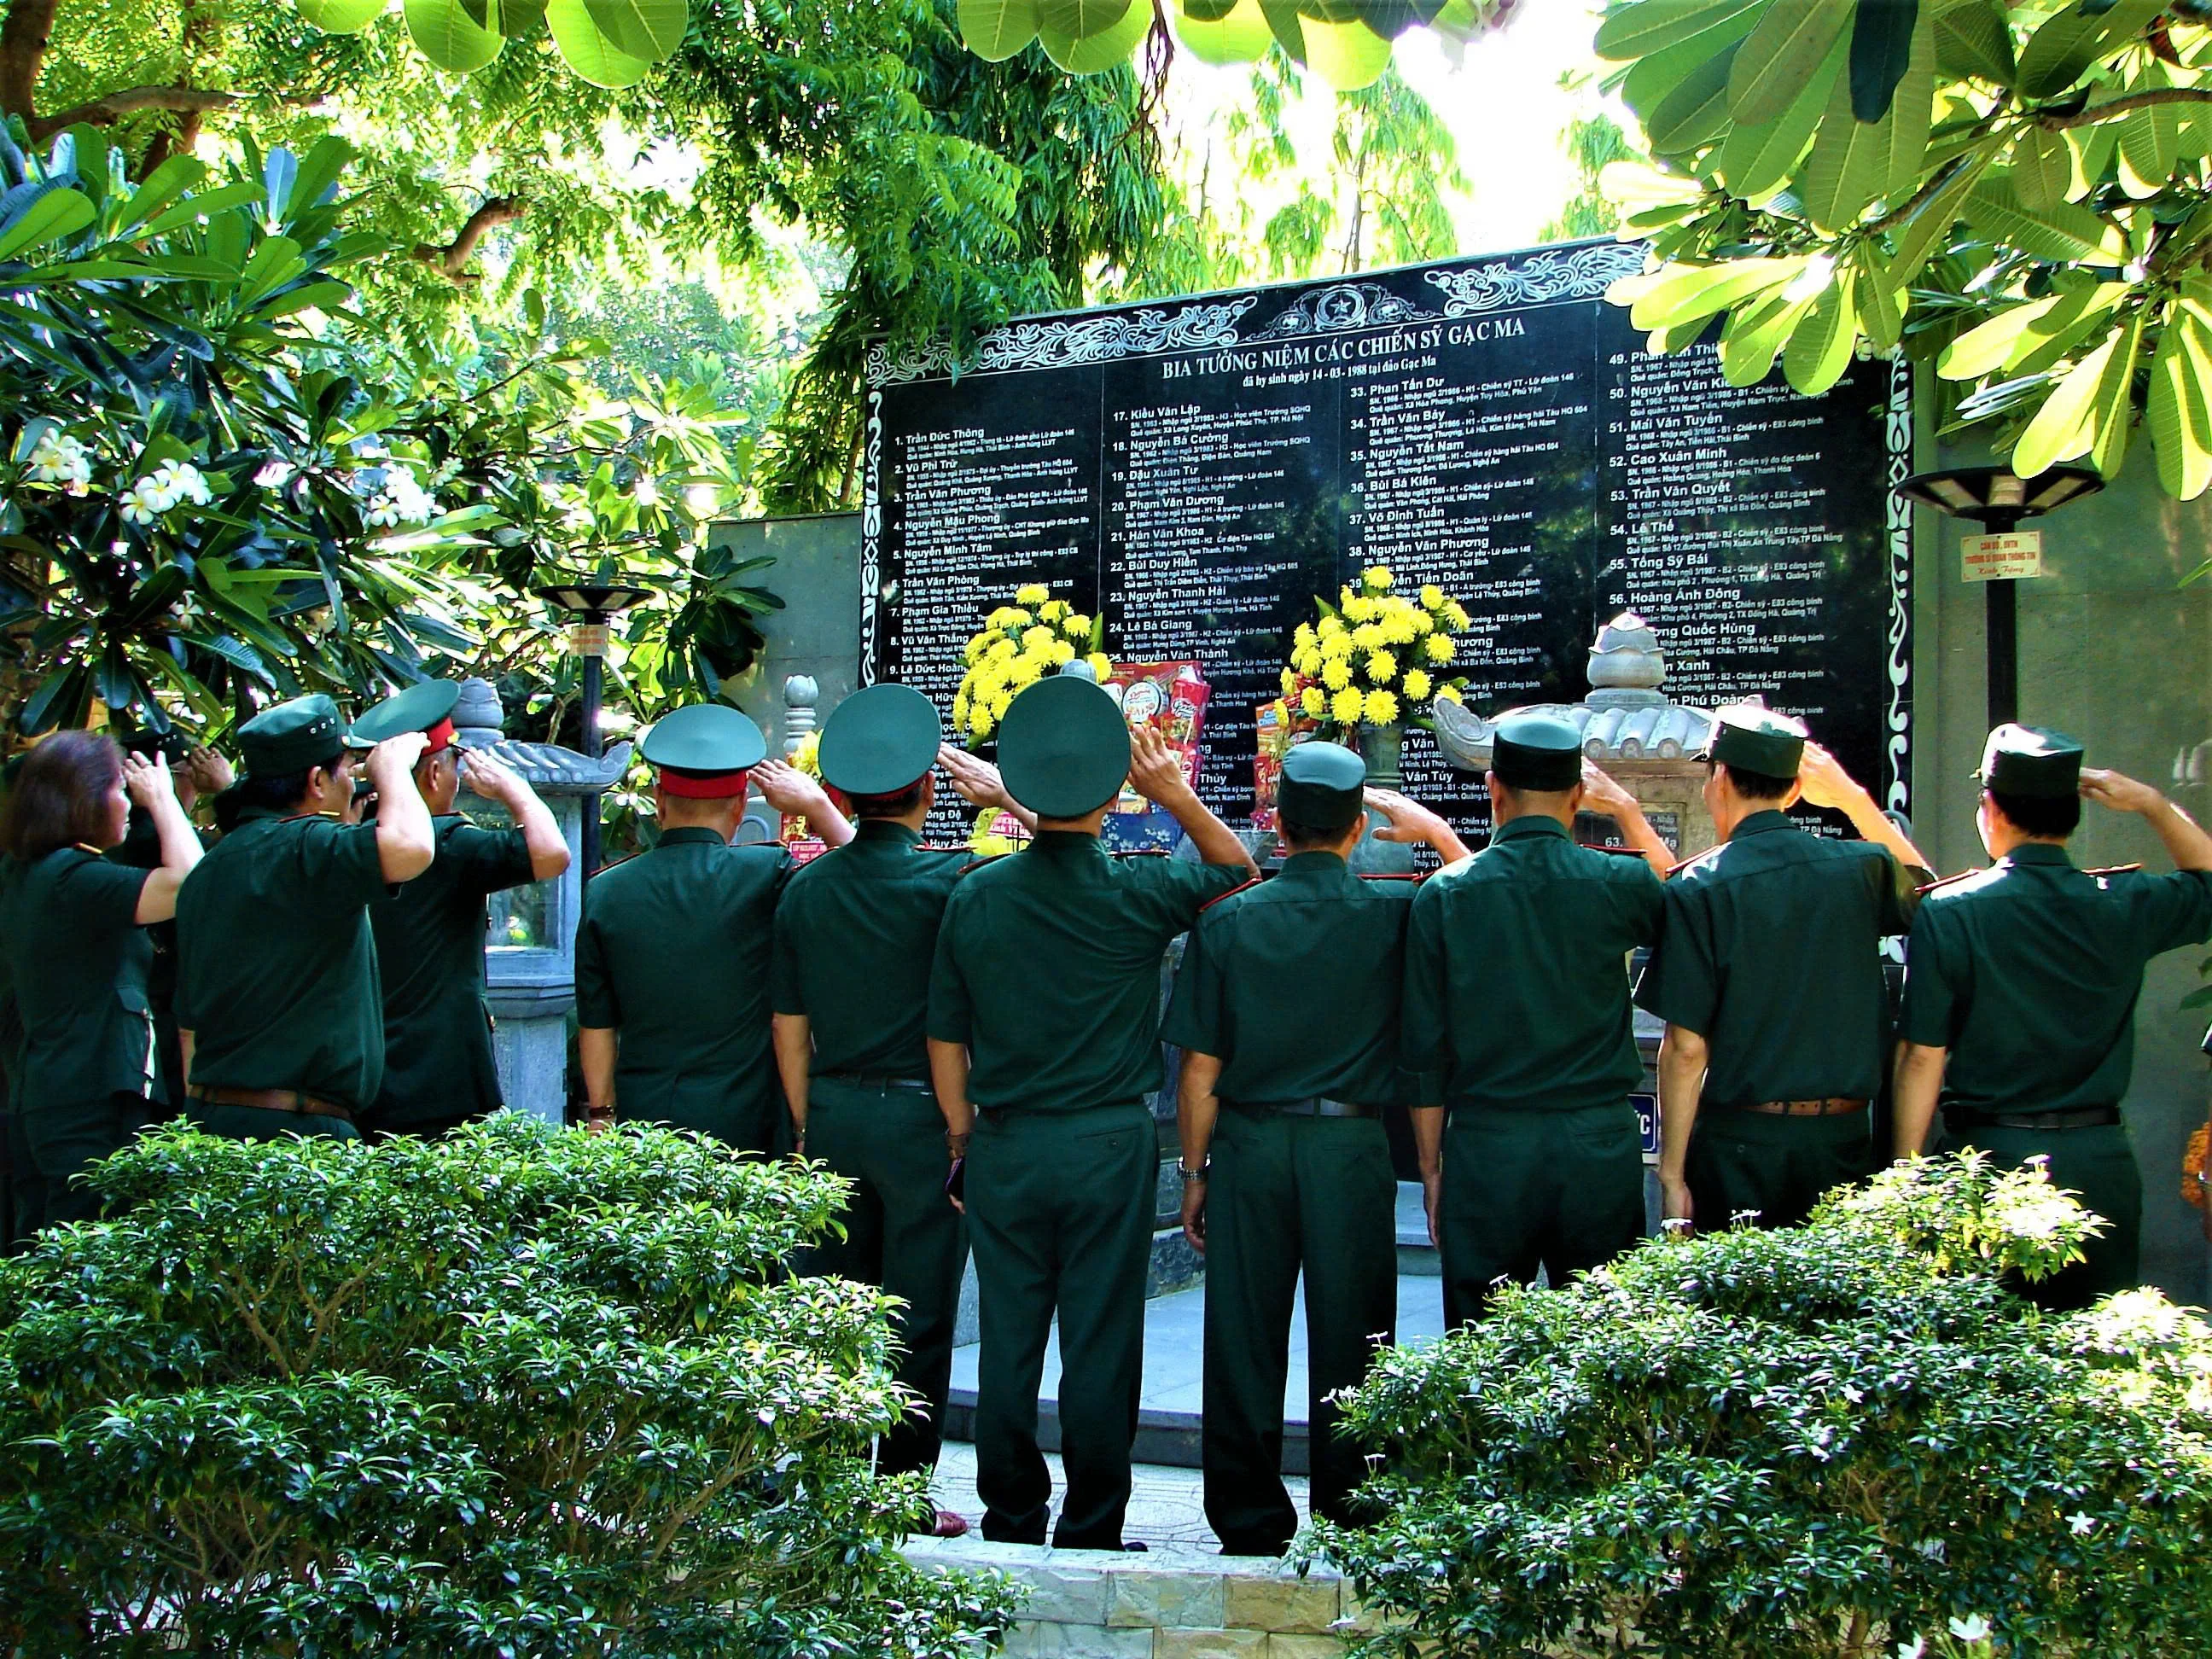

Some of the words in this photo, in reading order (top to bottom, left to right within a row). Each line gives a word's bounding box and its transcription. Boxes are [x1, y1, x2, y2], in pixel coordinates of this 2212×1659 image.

[1162, 359, 1191, 378] BIA
[1196, 349, 1257, 375] TƯỞNG
[1262, 344, 1310, 370] NIỆM
[1315, 338, 1353, 365] CÁC
[1359, 326, 1416, 357] CHIẾN
[1421, 323, 1443, 348] SỸ
[1449, 320, 1489, 346] GẠC
[1494, 317, 1525, 339] MA
[1610, 354, 1627, 364] 49.
[1243, 376, 1254, 387] đã
[1256, 375, 1266, 387] hy
[1268, 373, 1286, 384] sinh
[1289, 370, 1310, 384] ngày
[1313, 369, 1322, 380] 14
[1330, 368, 1341, 378] 03
[1348, 364, 1366, 377] 1988
[1368, 362, 1381, 375] tại
[1382, 358, 1399, 371] đảo
[1401, 358, 1419, 371] Gạc
[1422, 356, 1436, 367] Ma
[1351, 387, 1366, 398] 33.
[1370, 384, 1398, 395] Phan
[1610, 388, 1627, 399] 50.
[1114, 412, 1127, 421] 17.
[1351, 420, 1366, 430] 34.
[1610, 423, 1627, 434] 51.
[1113, 442, 1127, 451] 18.
[1350, 451, 1366, 461] 35.
[1438, 441, 1464, 451] Nam
[1610, 457, 1627, 467] 52.
[1631, 455, 1656, 465] Cao
[1696, 448, 1726, 460] Minh
[1112, 473, 1126, 481] 19.
[951, 486, 991, 498] Phương
[1351, 483, 1366, 492] 36.
[1610, 492, 1628, 501] 53.
[1112, 503, 1126, 511] 20.
[968, 514, 1000, 526] Phong
[1349, 515, 1365, 525] 37.
[1111, 533, 1126, 541] 21.
[1176, 527, 1204, 537] Khoa
[1610, 526, 1628, 535] 54.
[944, 544, 968, 555] Minh
[1349, 546, 1365, 556] 38.
[1441, 537, 1488, 550] Phương
[1110, 563, 1126, 572] 22.
[1150, 559, 1170, 571] Duy
[1610, 559, 1627, 569] 55.
[1110, 593, 1125, 602] 23.
[1172, 589, 1205, 599] Thanh
[1610, 594, 1627, 604] 56.
[1109, 624, 1124, 632] 24.
[1161, 620, 1191, 632] Giang
[1677, 660, 1709, 670] Xanh
[890, 667, 898, 675] 9.
[1605, 837, 1622, 847] 63.
